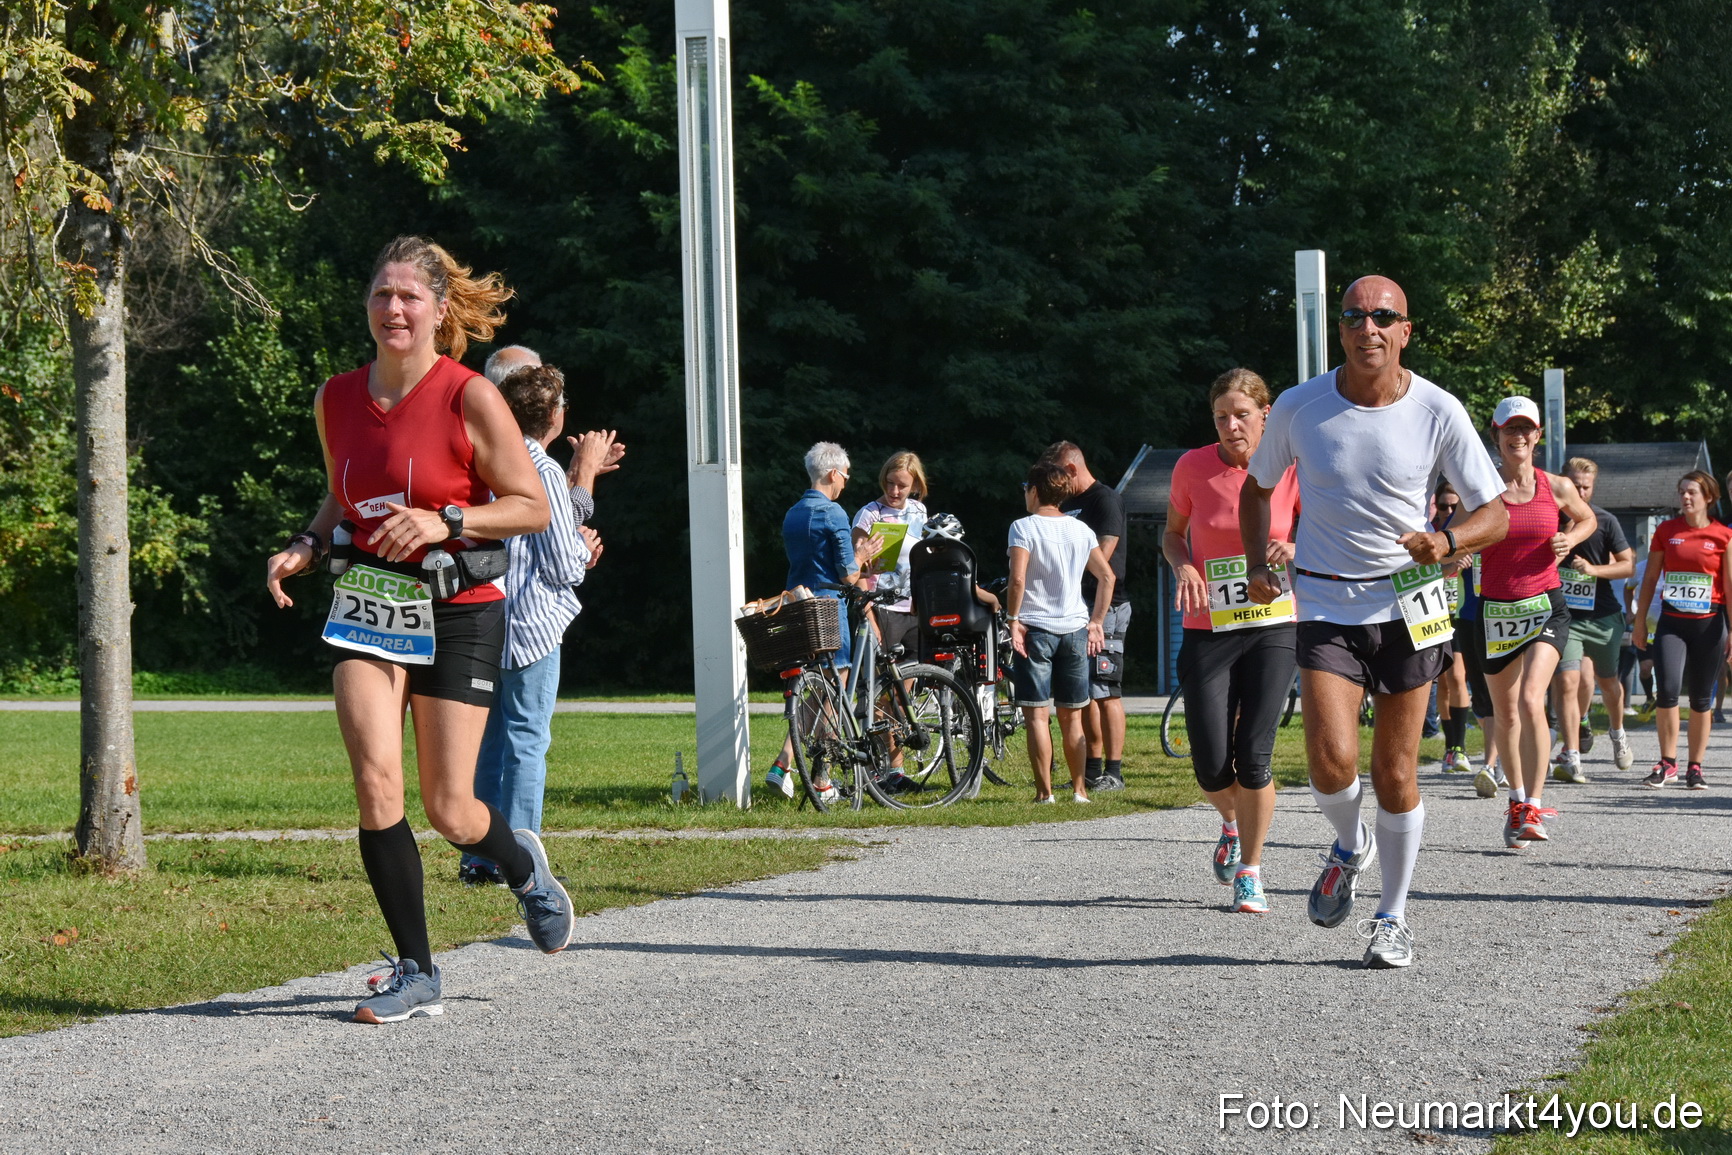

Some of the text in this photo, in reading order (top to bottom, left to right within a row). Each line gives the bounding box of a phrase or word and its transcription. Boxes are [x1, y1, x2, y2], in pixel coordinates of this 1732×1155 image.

[341, 569, 432, 601] BOCK
[1669, 574, 1709, 585] BOCK
[1218, 582, 1249, 605] 13
[1412, 586, 1444, 616] 11
[1669, 586, 1706, 599] 2167
[343, 595, 421, 630] 2575
[1234, 607, 1272, 621] HEIKE
[1488, 598, 1546, 617] BOCK
[1494, 615, 1545, 638] 1275
[346, 630, 415, 652] ANDREA
